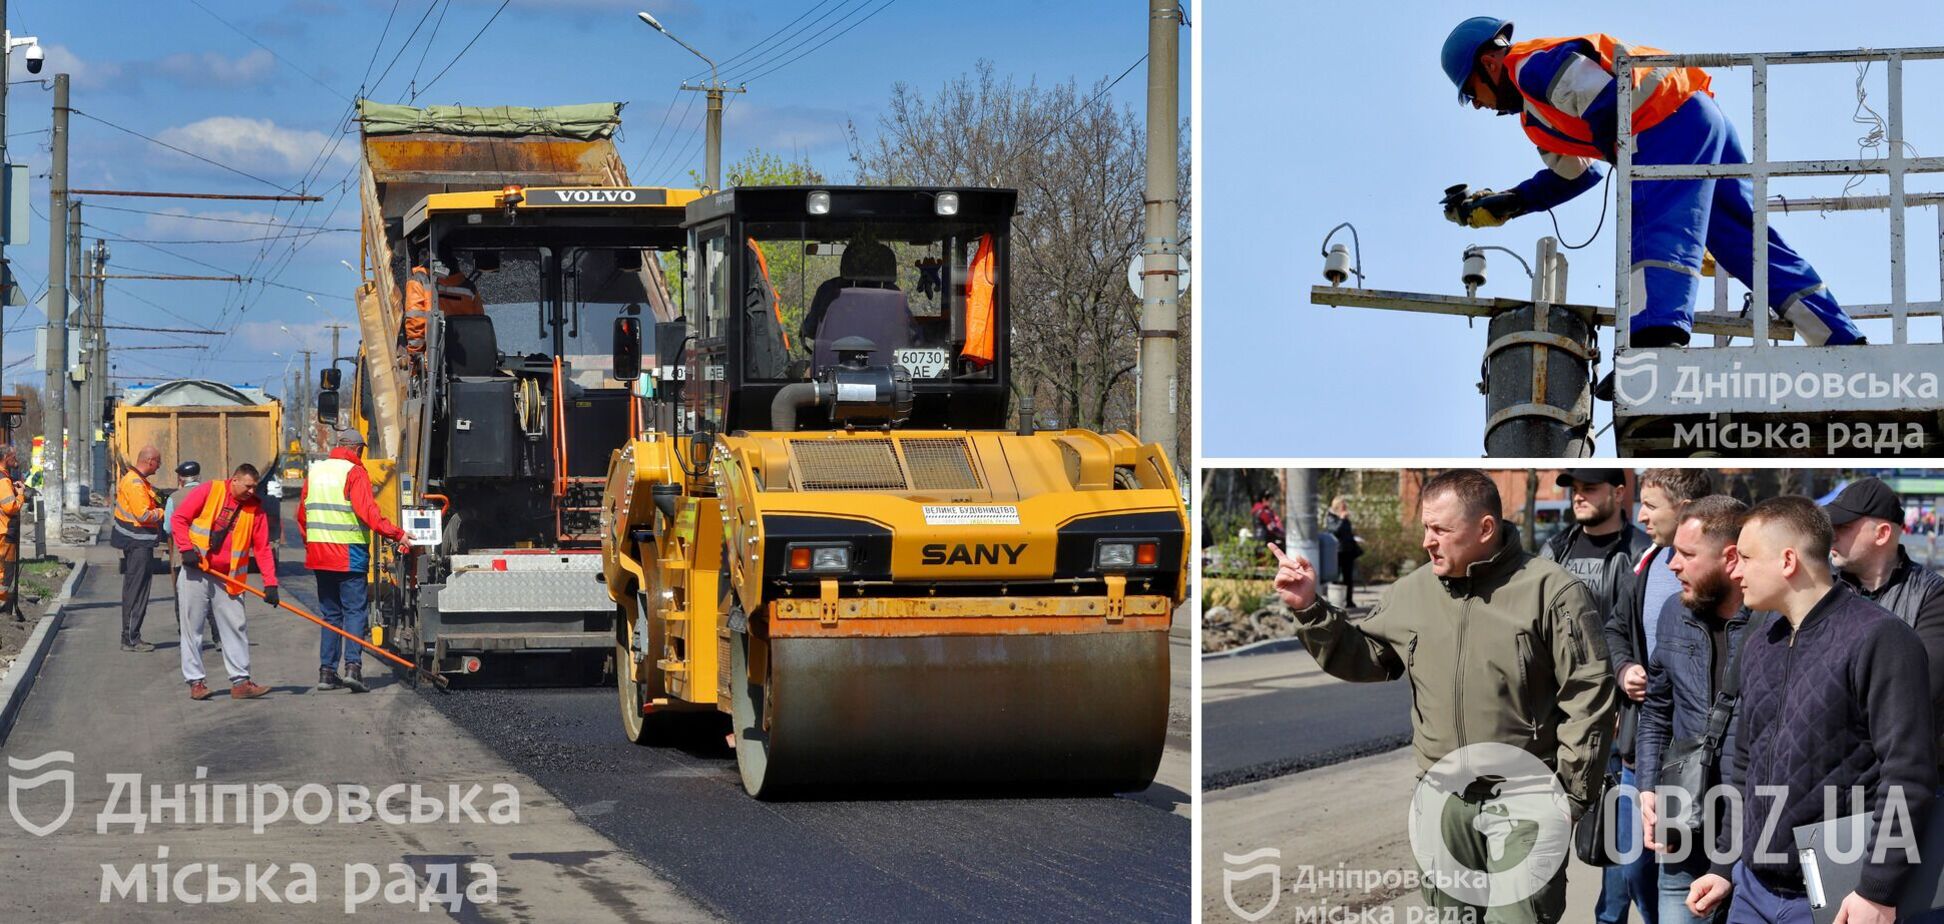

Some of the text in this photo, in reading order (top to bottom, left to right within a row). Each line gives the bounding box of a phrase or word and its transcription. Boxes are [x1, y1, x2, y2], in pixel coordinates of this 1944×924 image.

[555, 190, 636, 202] VOLVO
[902, 351, 942, 364] 60730
[925, 506, 1015, 515] ВЕЛИКЕ БУДІВНИЦТВО
[922, 543, 1029, 565] SANY
